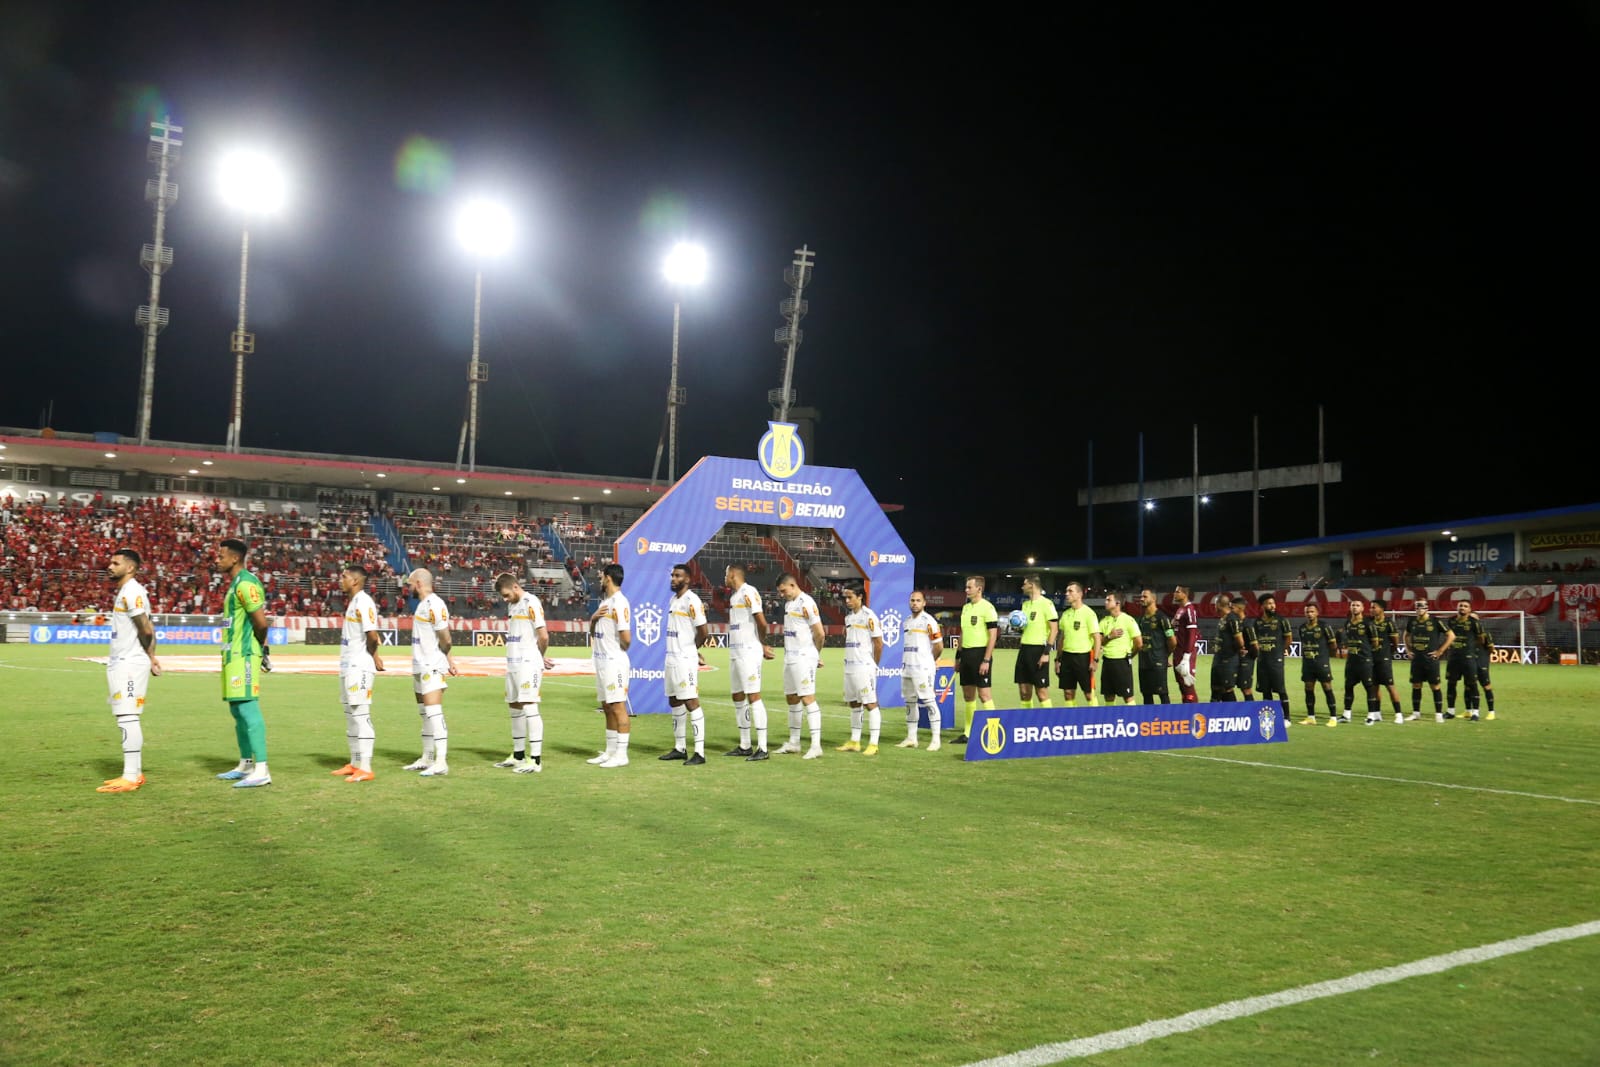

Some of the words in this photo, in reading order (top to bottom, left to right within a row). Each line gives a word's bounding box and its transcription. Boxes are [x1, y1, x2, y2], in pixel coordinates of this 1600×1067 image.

[732, 478, 832, 496] BRASILEIRÃO
[715, 494, 774, 514] SÉRIE
[795, 502, 846, 519] BETANO
[649, 541, 687, 554] BETANO
[1448, 543, 1499, 563] smile
[879, 554, 906, 564] BETANO
[166, 628, 211, 640] SÉRIE
[476, 633, 508, 647] BRA
[1490, 649, 1533, 664] BRAX
[629, 668, 665, 681] uhlspor
[1013, 719, 1139, 743] BRASILEIRÃO
[1140, 717, 1190, 736] SÉRIE
[1208, 716, 1251, 733] BETANO
